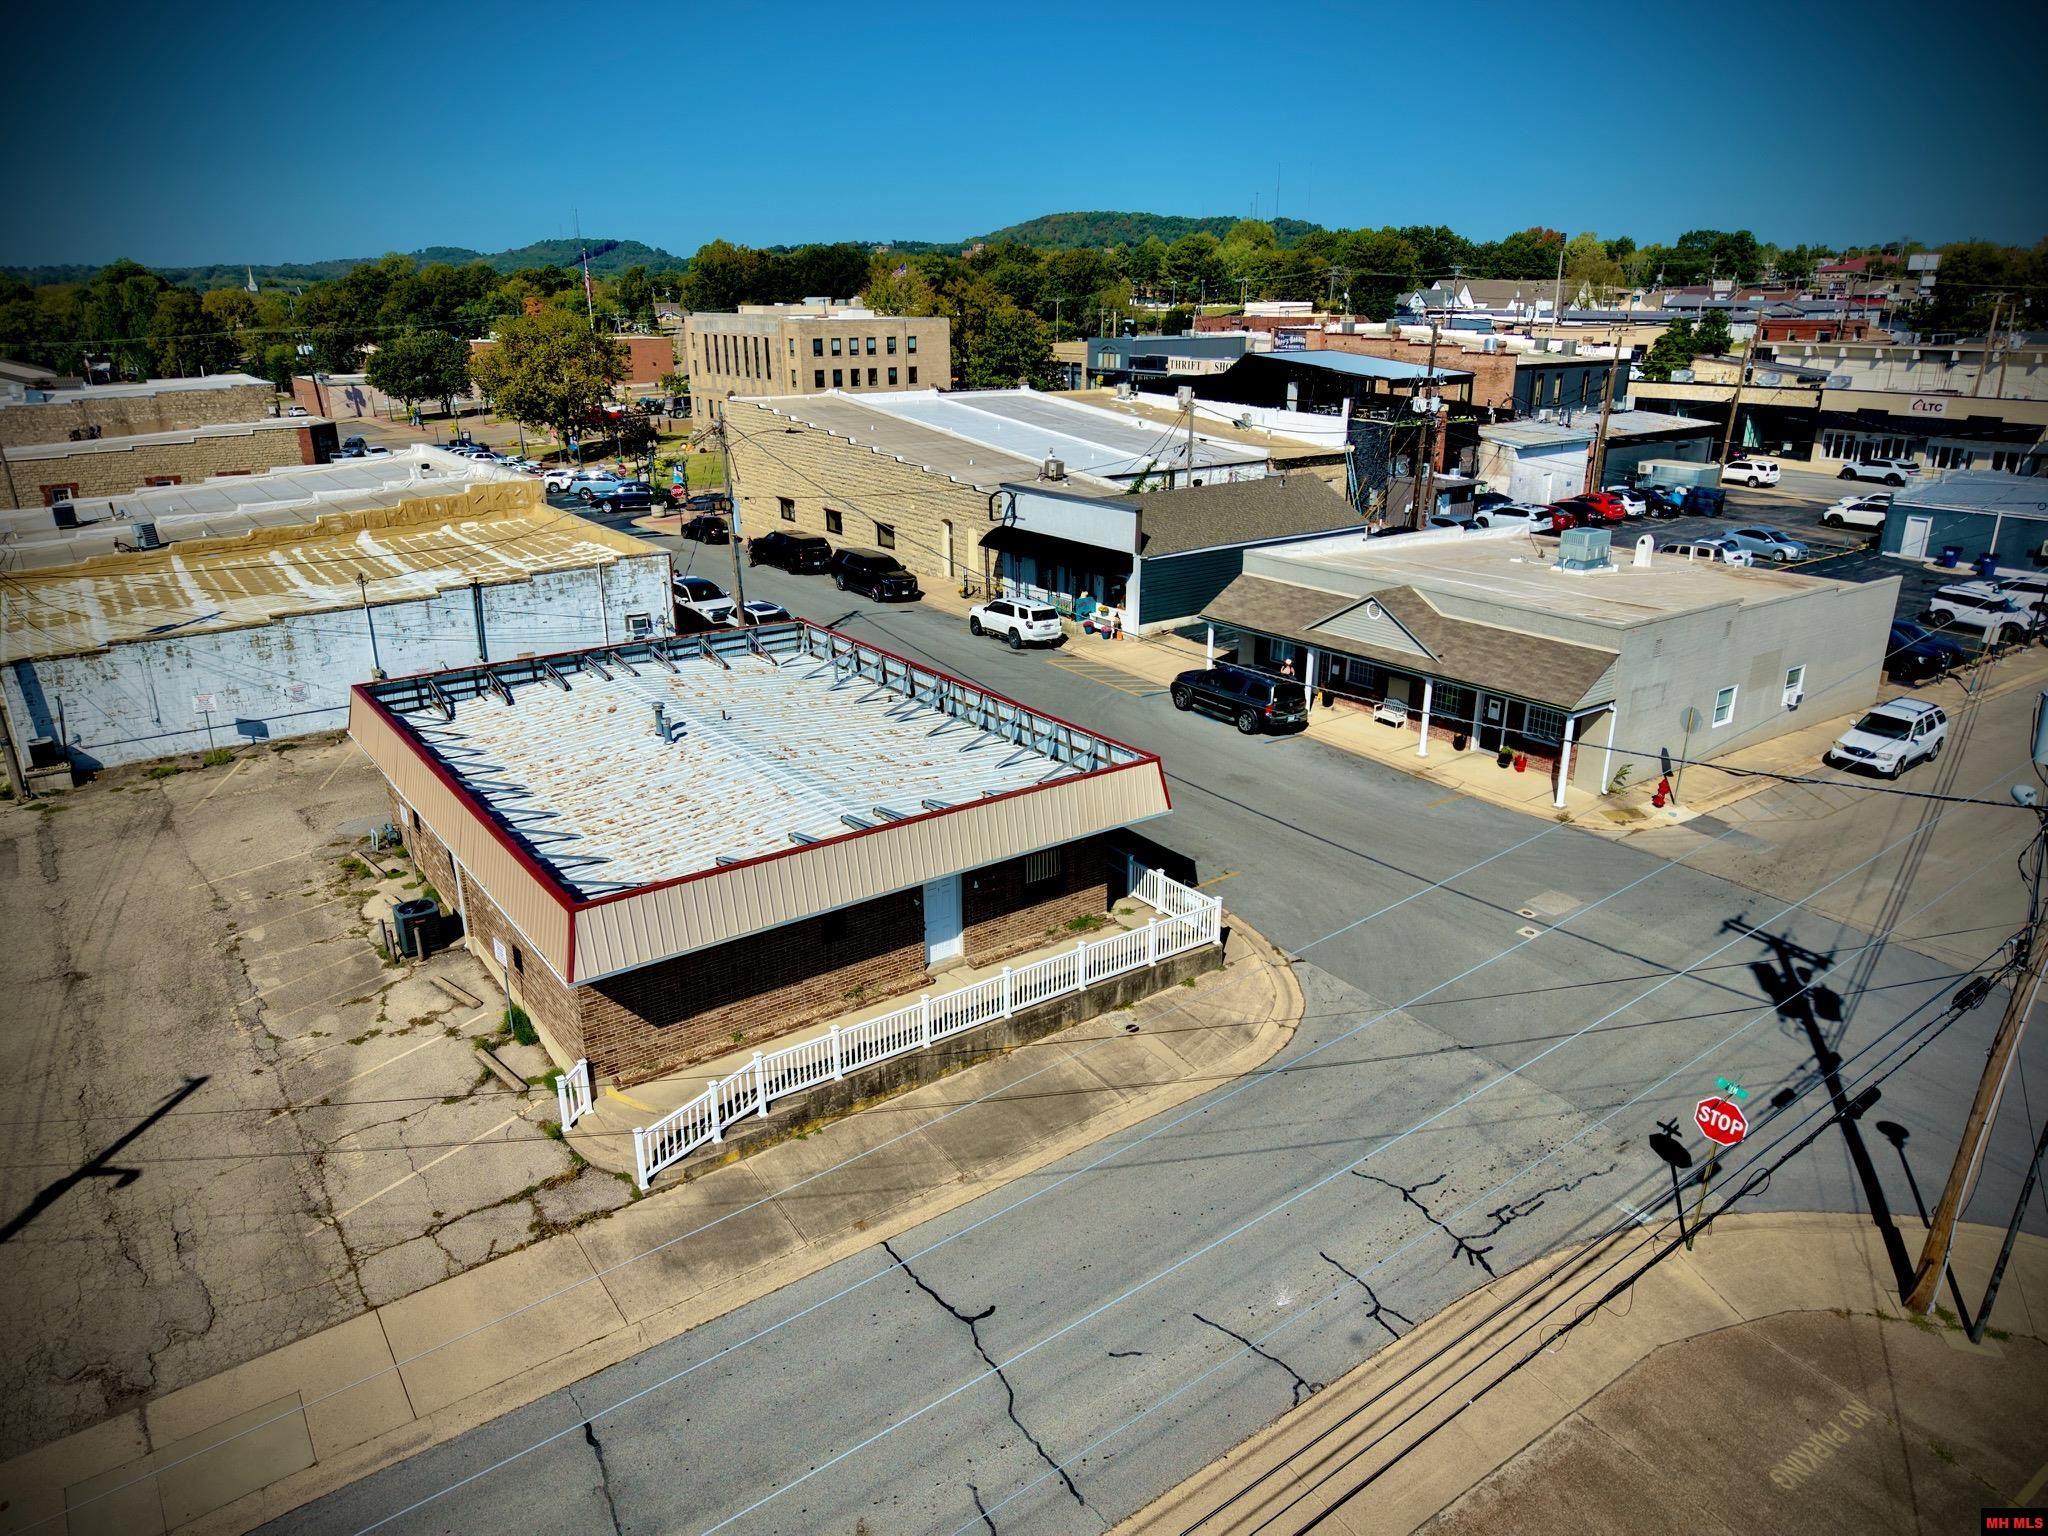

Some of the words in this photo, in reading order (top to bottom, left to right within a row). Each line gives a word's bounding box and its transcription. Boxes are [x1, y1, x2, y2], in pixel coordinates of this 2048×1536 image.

[1170, 359, 1202, 371] THRIFT
[1214, 361, 1234, 372] SHO
[1698, 1106, 1744, 1135] STOP
[1839, 1398, 1876, 1430] NO
[1769, 1421, 1851, 1490] PARKING
